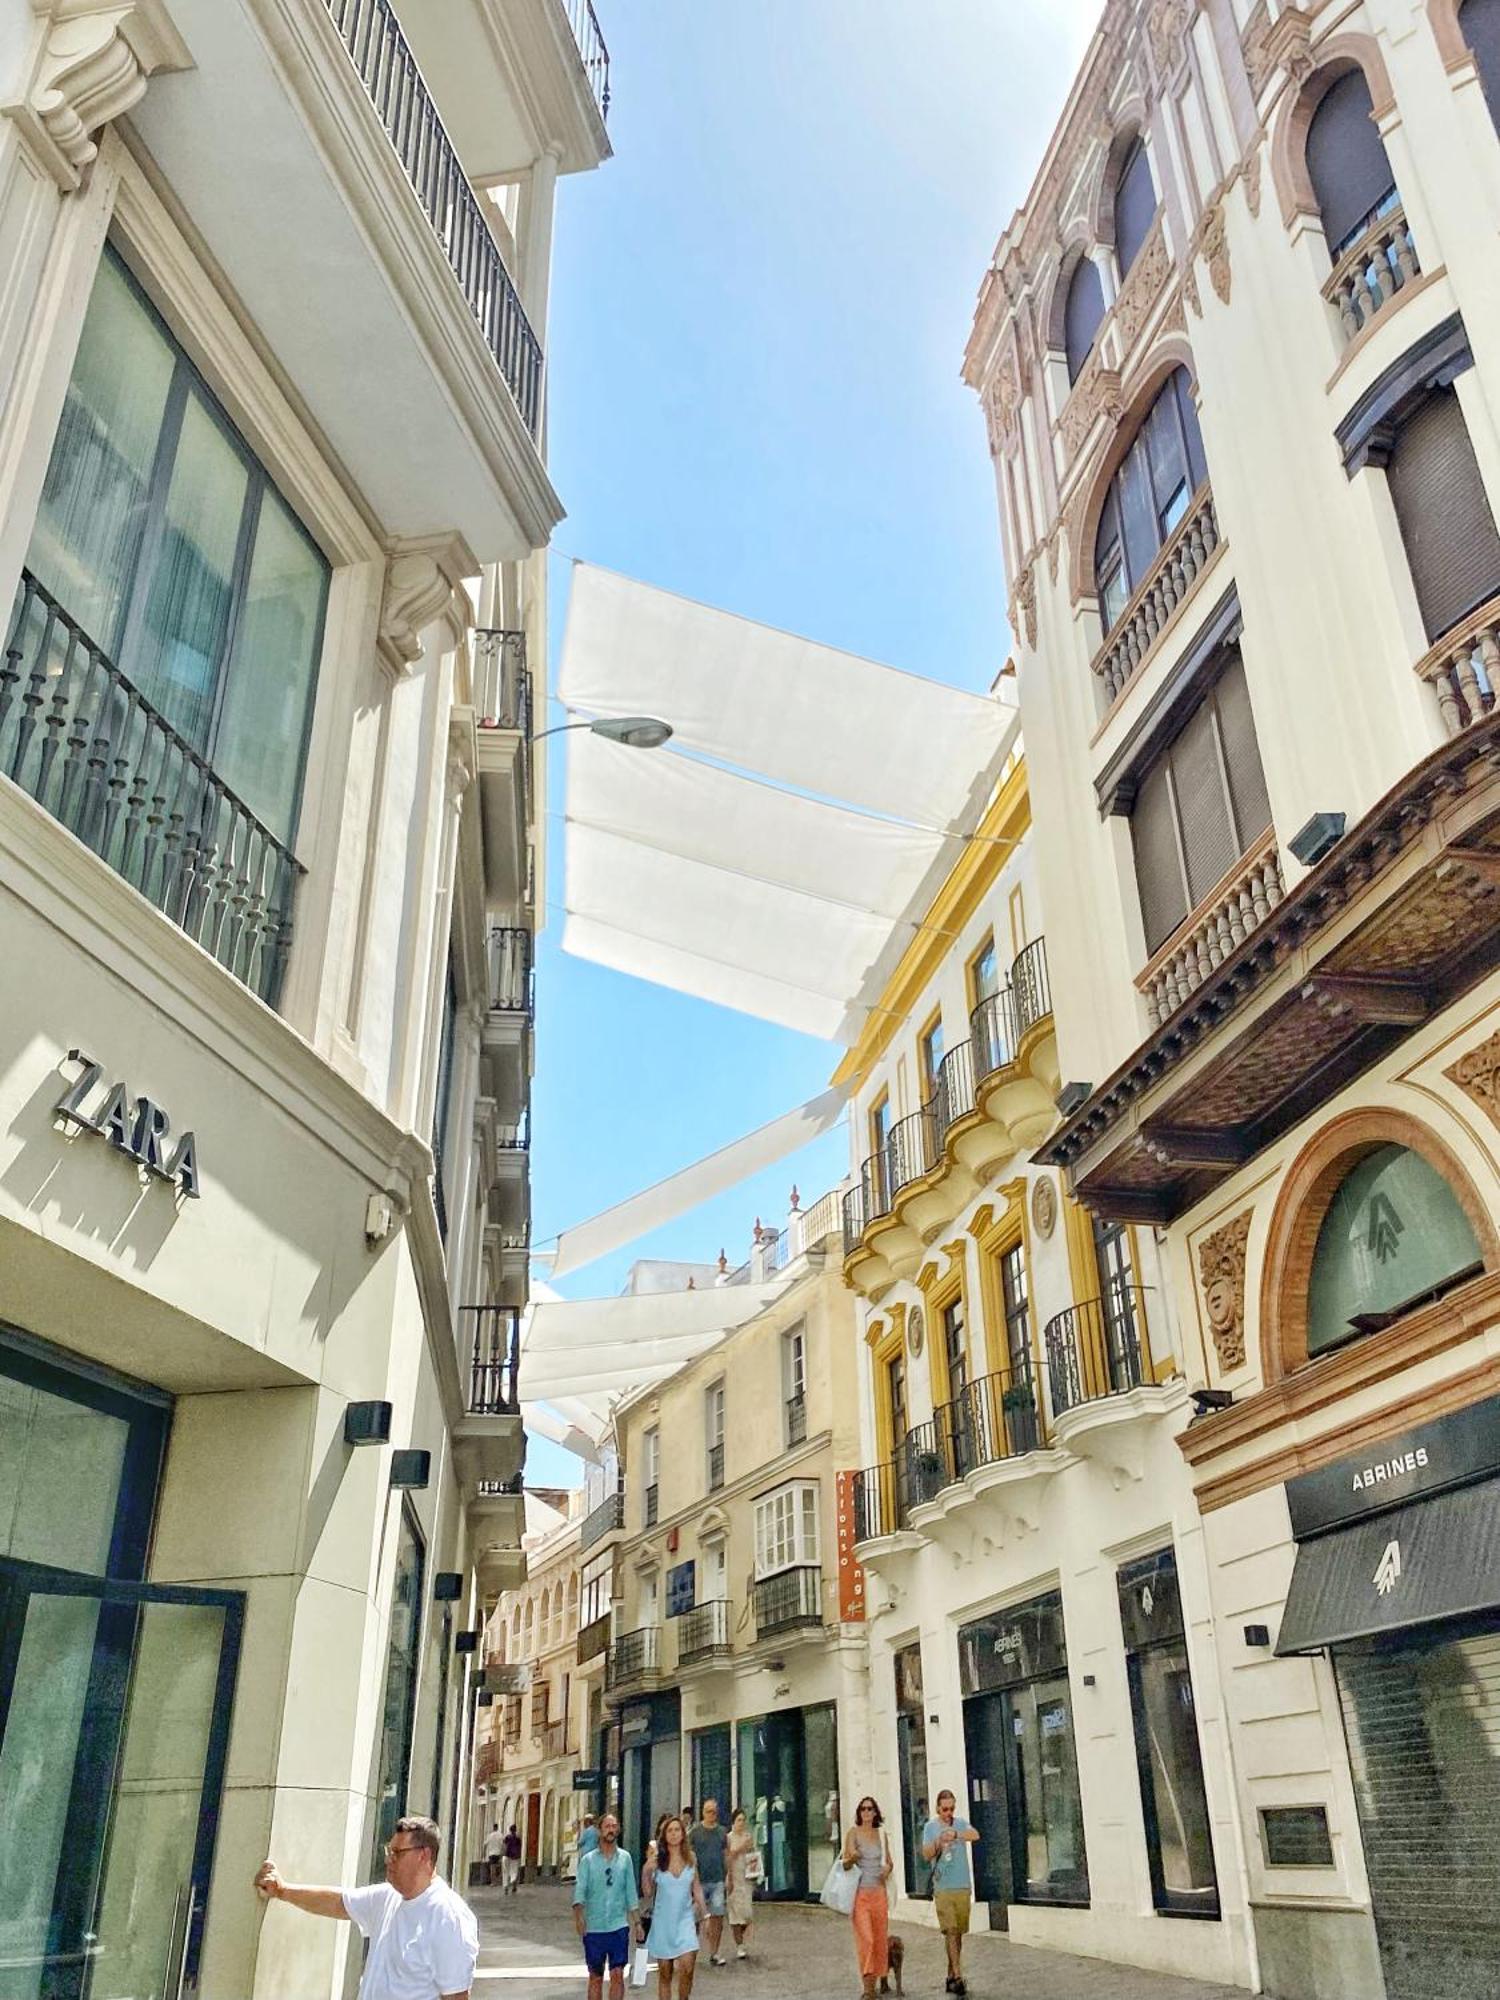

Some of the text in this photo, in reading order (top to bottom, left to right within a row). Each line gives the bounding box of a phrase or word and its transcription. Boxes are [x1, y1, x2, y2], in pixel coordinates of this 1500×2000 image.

[55, 1049, 201, 1200] ZARA
[1352, 1447, 1429, 1492] ABRINES
[837, 1471, 849, 1567] Alfonso
